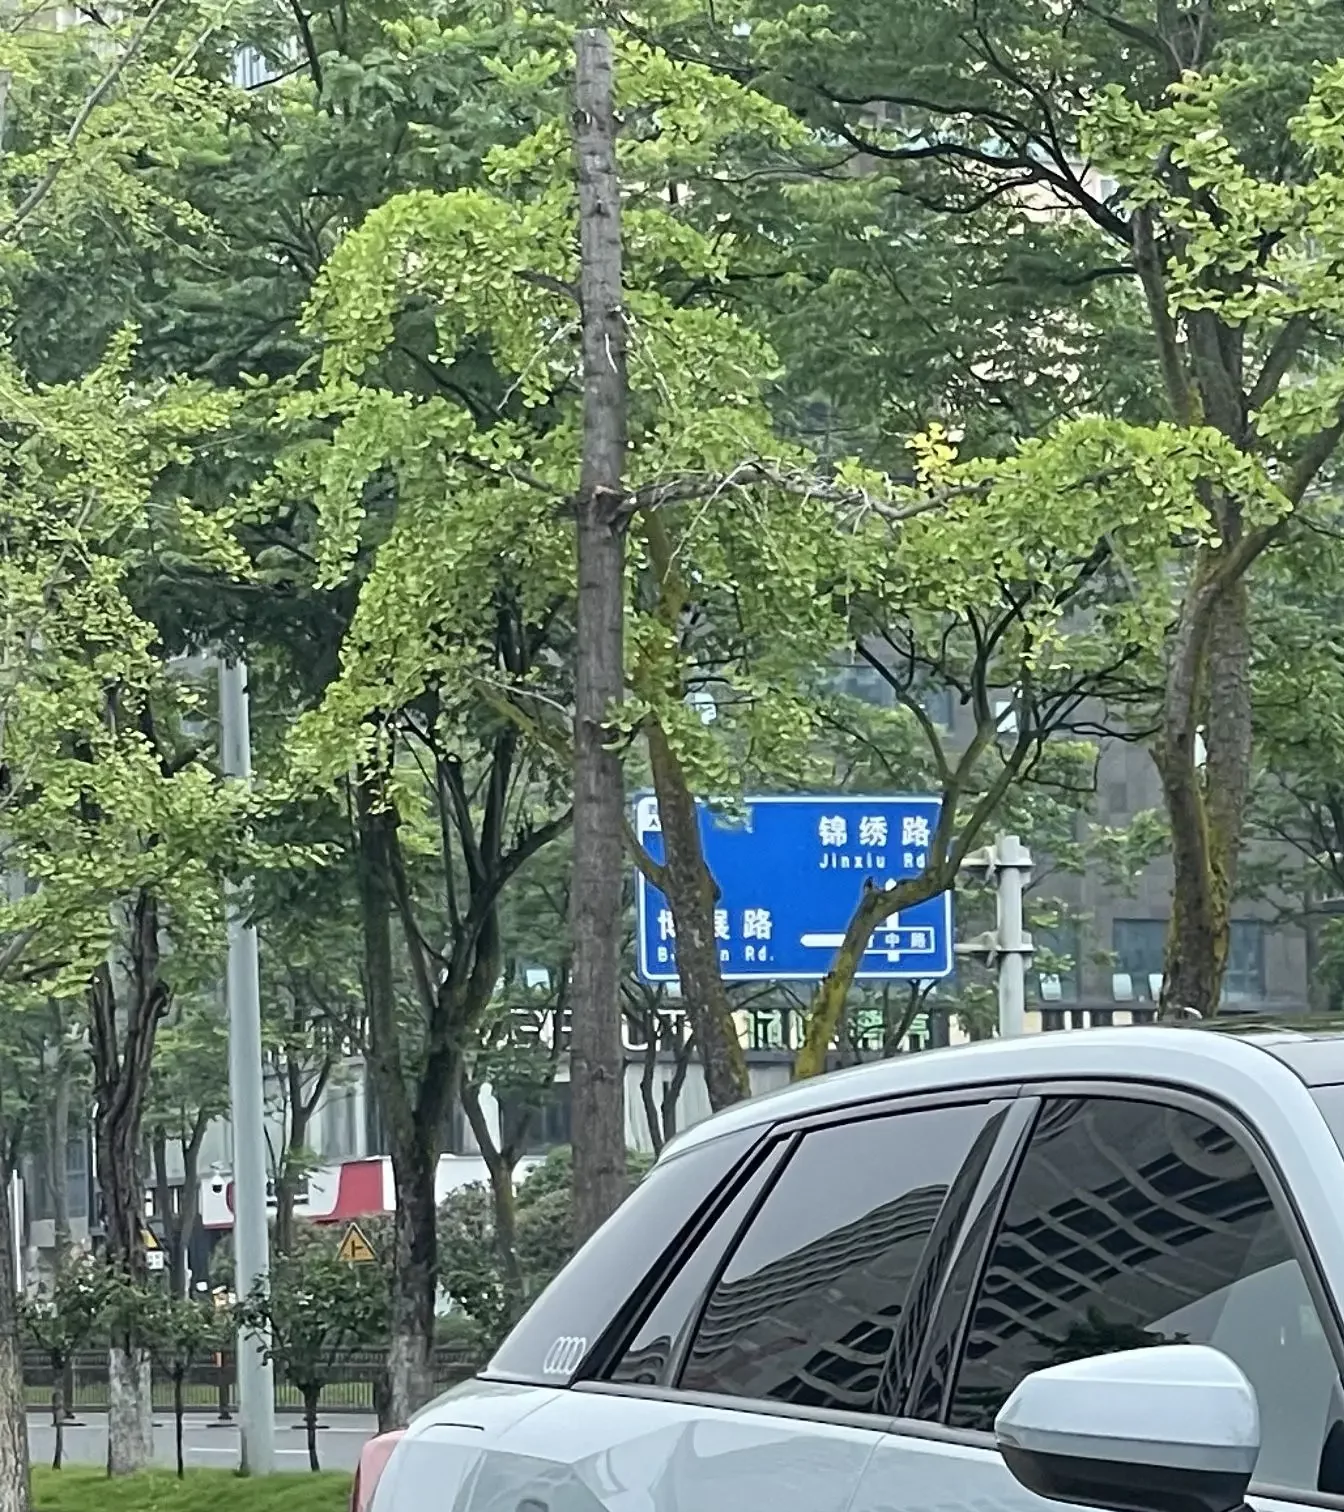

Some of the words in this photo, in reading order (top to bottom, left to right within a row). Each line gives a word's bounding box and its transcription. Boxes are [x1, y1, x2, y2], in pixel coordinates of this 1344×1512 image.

[818, 815, 931, 847] 锦绣路
[819, 852, 886, 869] Jinxiu
[744, 945, 774, 962] Rd.
